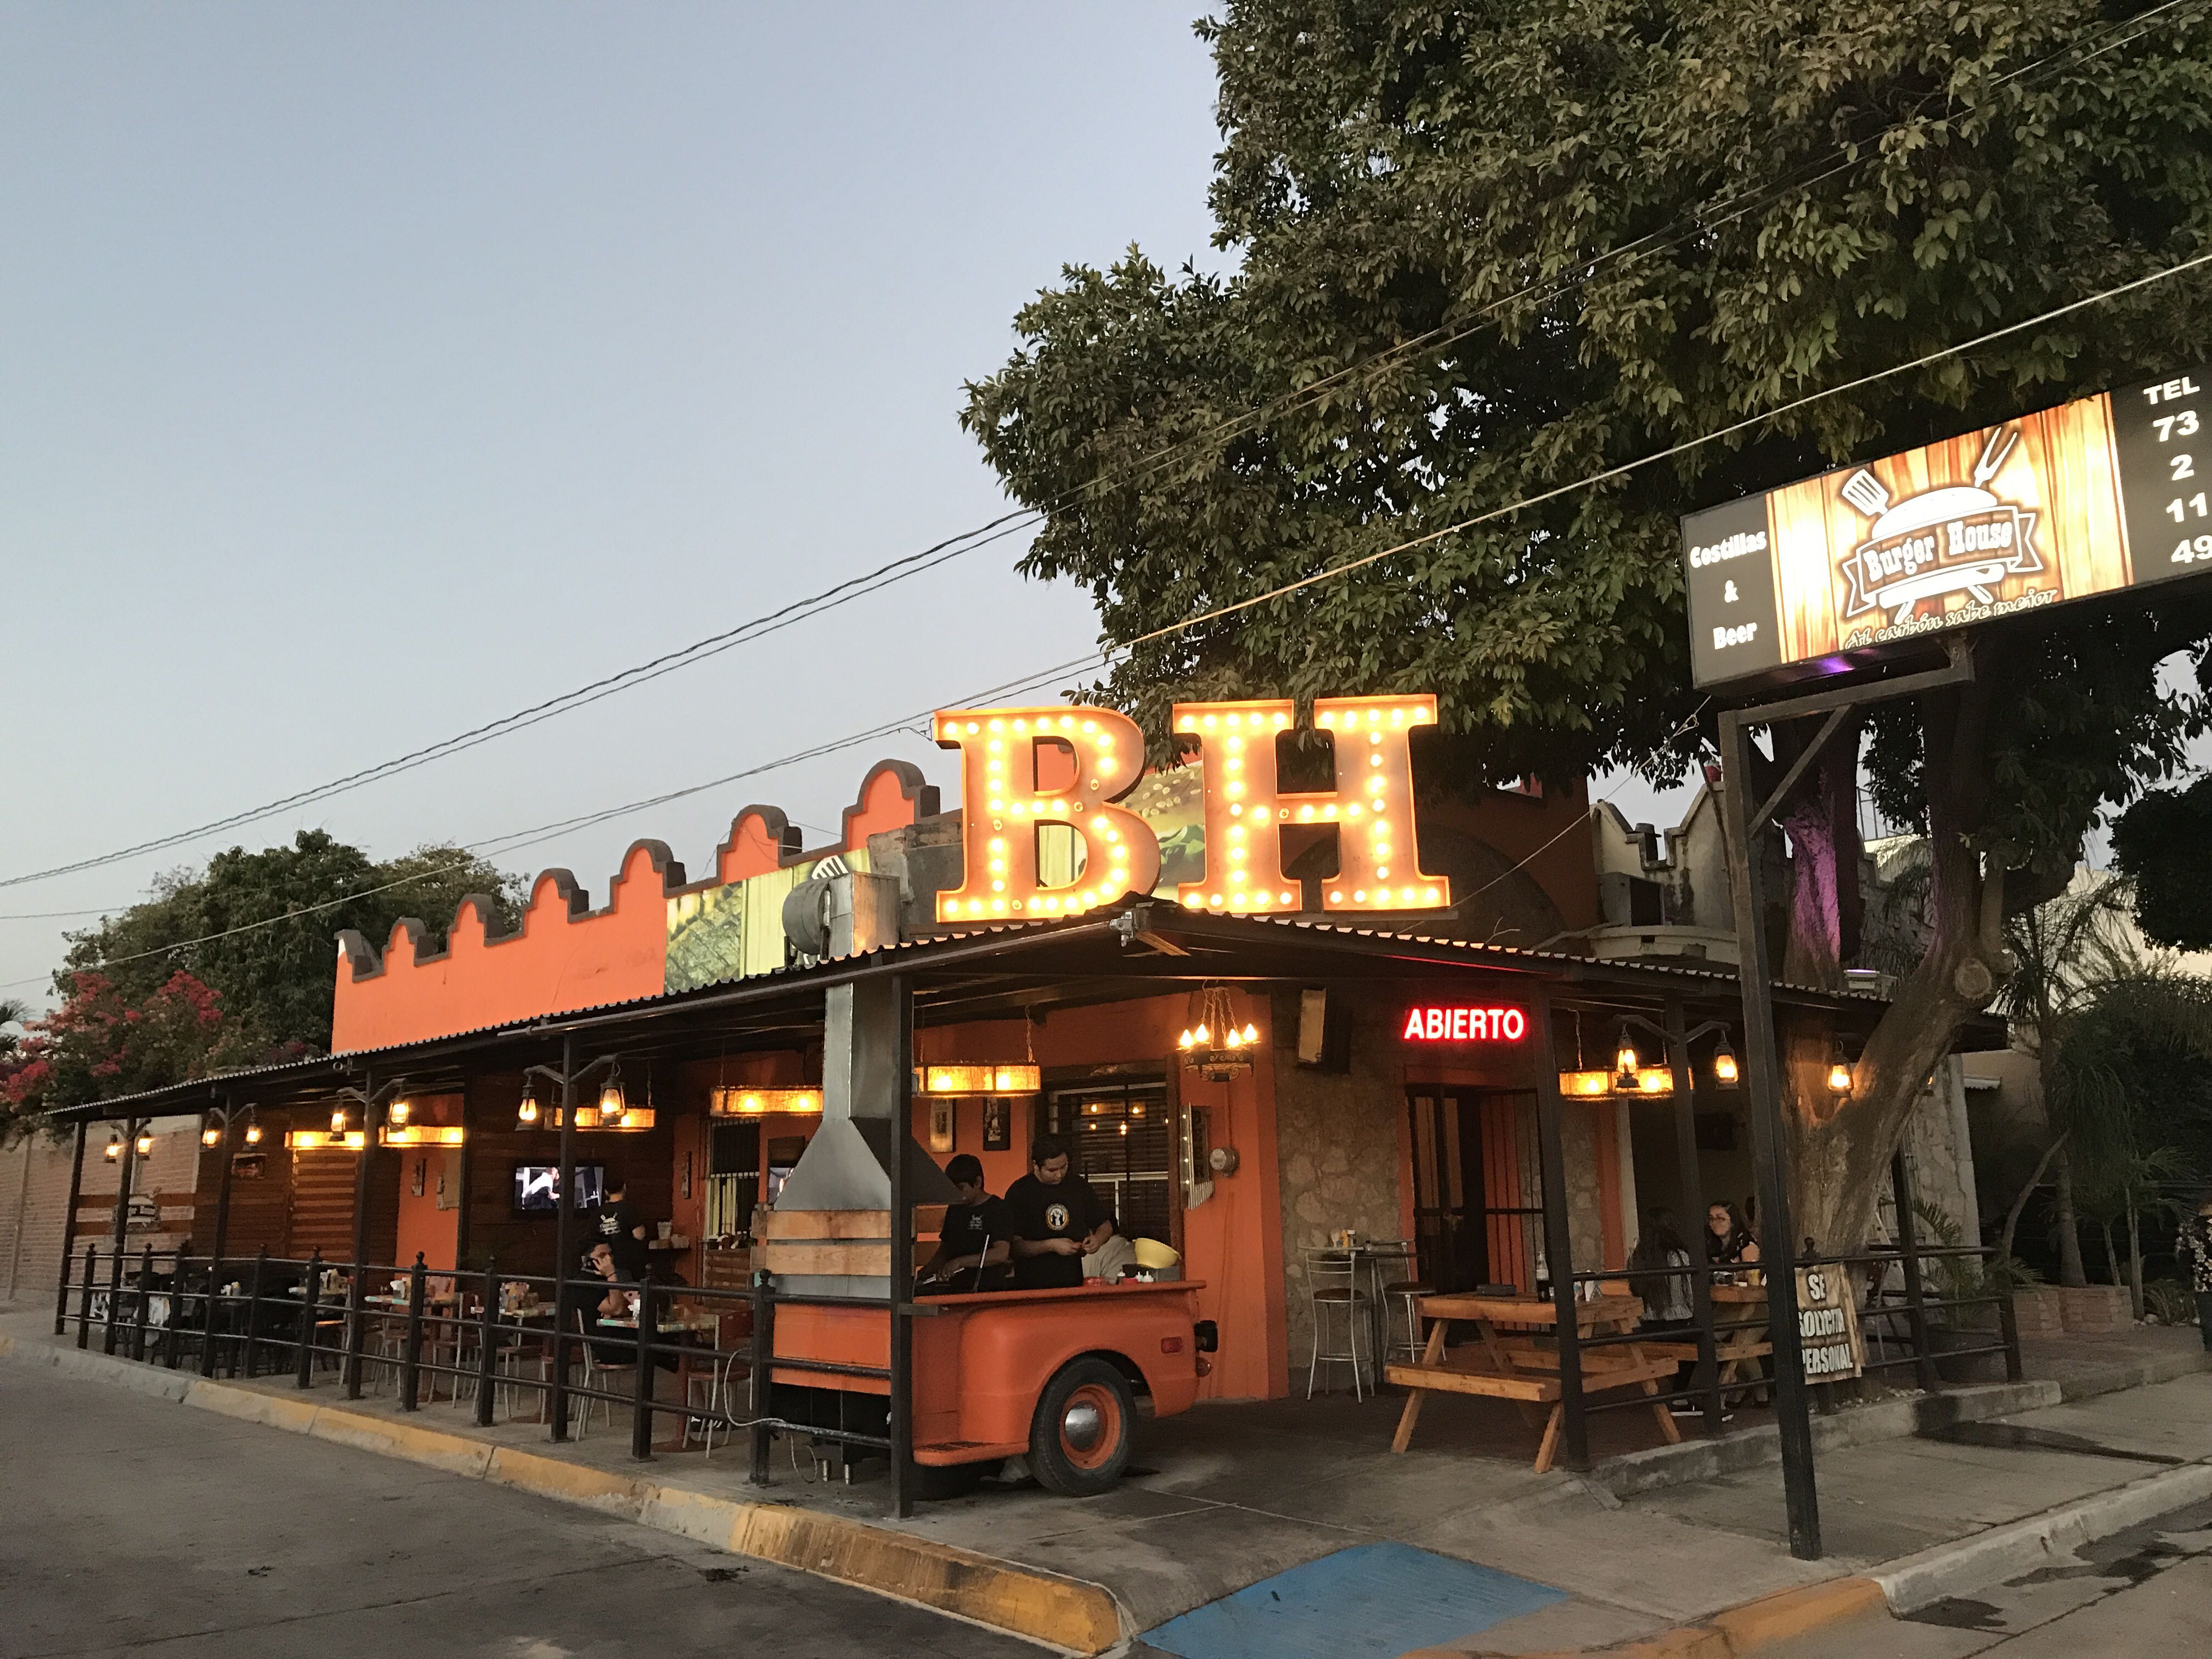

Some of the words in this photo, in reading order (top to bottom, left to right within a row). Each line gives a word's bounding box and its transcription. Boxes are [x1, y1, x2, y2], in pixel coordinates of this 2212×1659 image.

[2143, 376, 2200, 405] TEL
[2153, 410, 2199, 442] 73
[2170, 454, 2194, 481] 2
[2166, 492, 2208, 523] 11
[1690, 531, 1767, 568] Costillas
[1863, 535, 1935, 582] Burger
[1947, 520, 2013, 556] House
[2171, 535, 2212, 563] 49
[1724, 580, 1739, 603] &
[1713, 622, 1757, 650] Beer
[1845, 628, 1872, 650] Al
[1875, 613, 1943, 642] carbón
[1945, 600, 1991, 627] sabe
[1404, 1009, 1523, 1039] ABIERTO
[1808, 1273, 1826, 1300] SE
